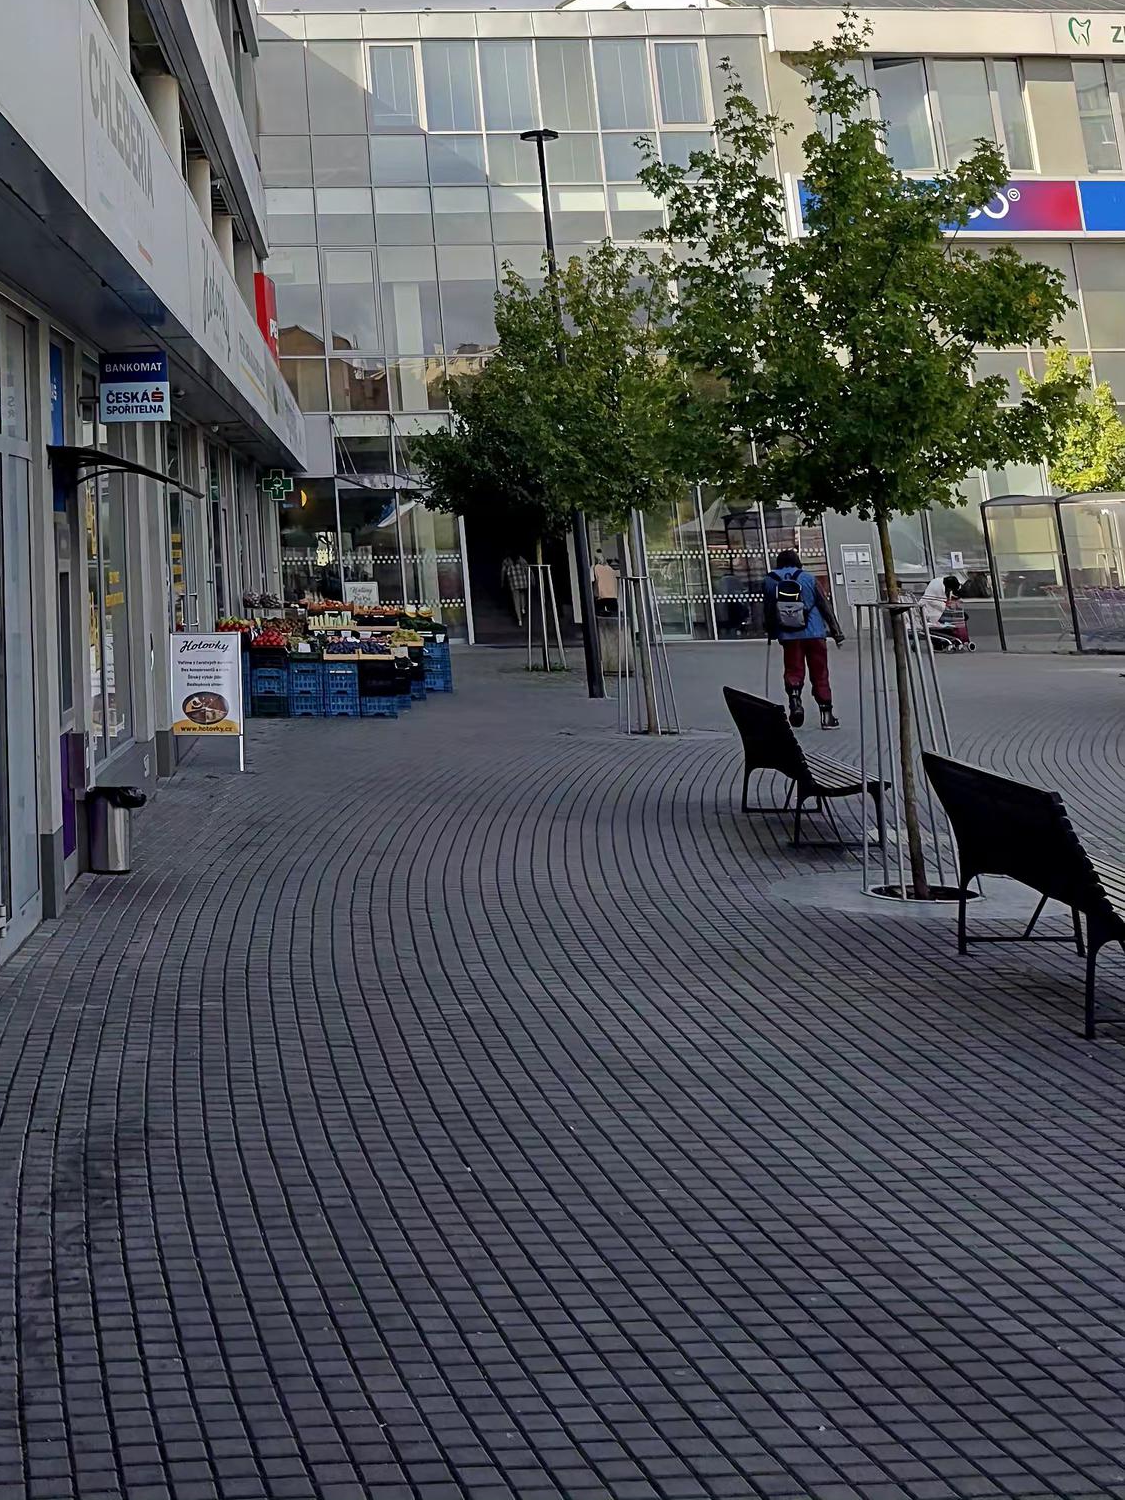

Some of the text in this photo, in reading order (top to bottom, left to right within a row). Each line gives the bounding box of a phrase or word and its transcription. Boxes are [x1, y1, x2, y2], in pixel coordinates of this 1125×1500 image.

[1111, 25, 1125, 43] Z
[105, 362, 163, 373] BANKOMAT
[106, 389, 150, 404] ČESKÁ
[106, 404, 164, 415] SPOŘITELNA
[180, 640, 230, 653] Hotovky
